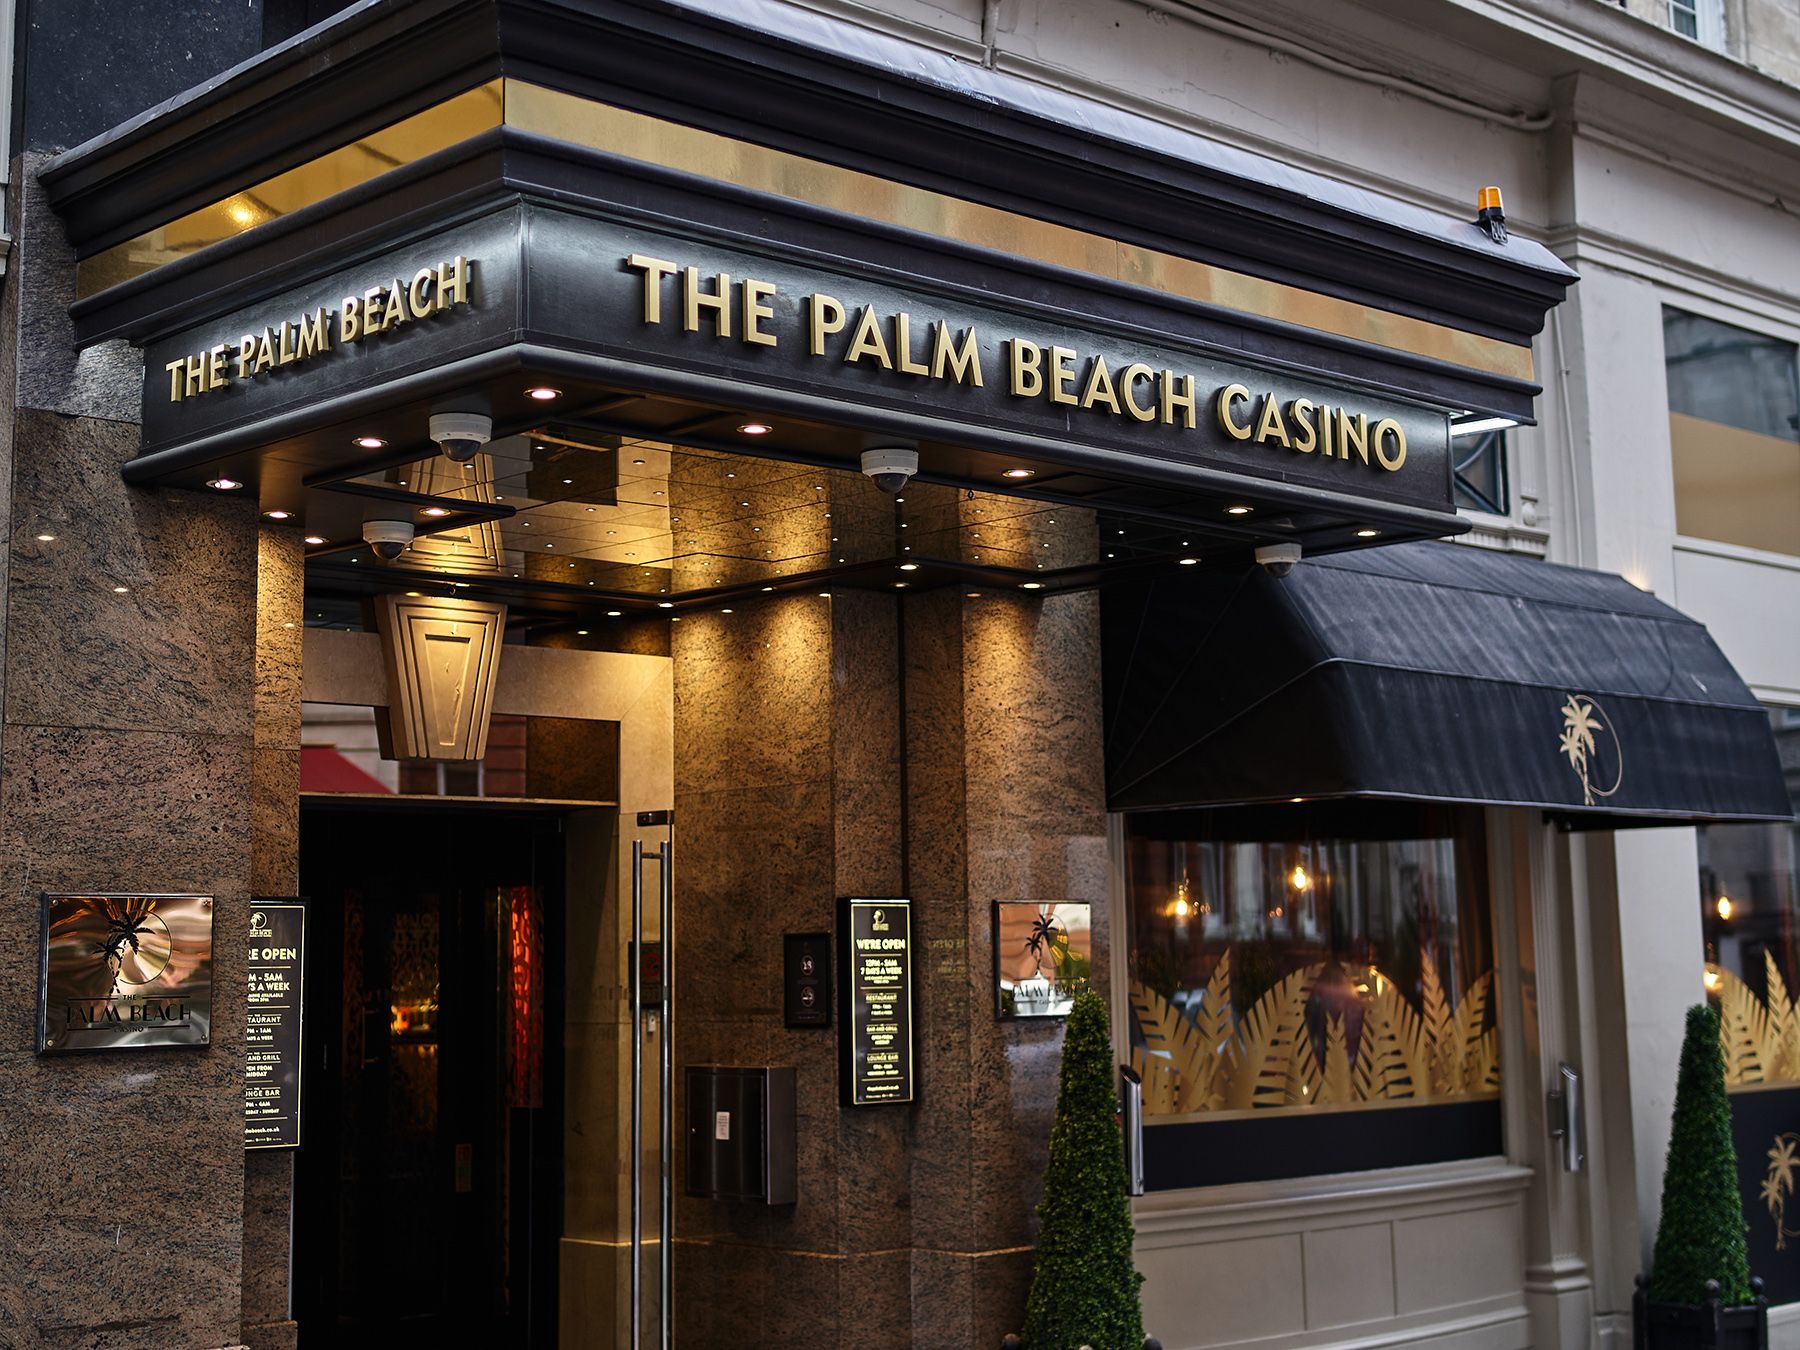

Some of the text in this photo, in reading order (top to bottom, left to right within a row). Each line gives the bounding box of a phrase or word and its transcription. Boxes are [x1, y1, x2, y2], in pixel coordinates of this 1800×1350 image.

[165, 255, 468, 402] THE PALM BEACH
[627, 254, 1407, 472] THE PALM BEACH CASINO
[882, 939, 906, 950] OPEN
[262, 947, 297, 961] OPEN
[264, 973, 283, 981] 5AM
[257, 983, 265, 991] A
[266, 982, 290, 991] WEEK
[66, 1003, 191, 1024] PALM BEACH
